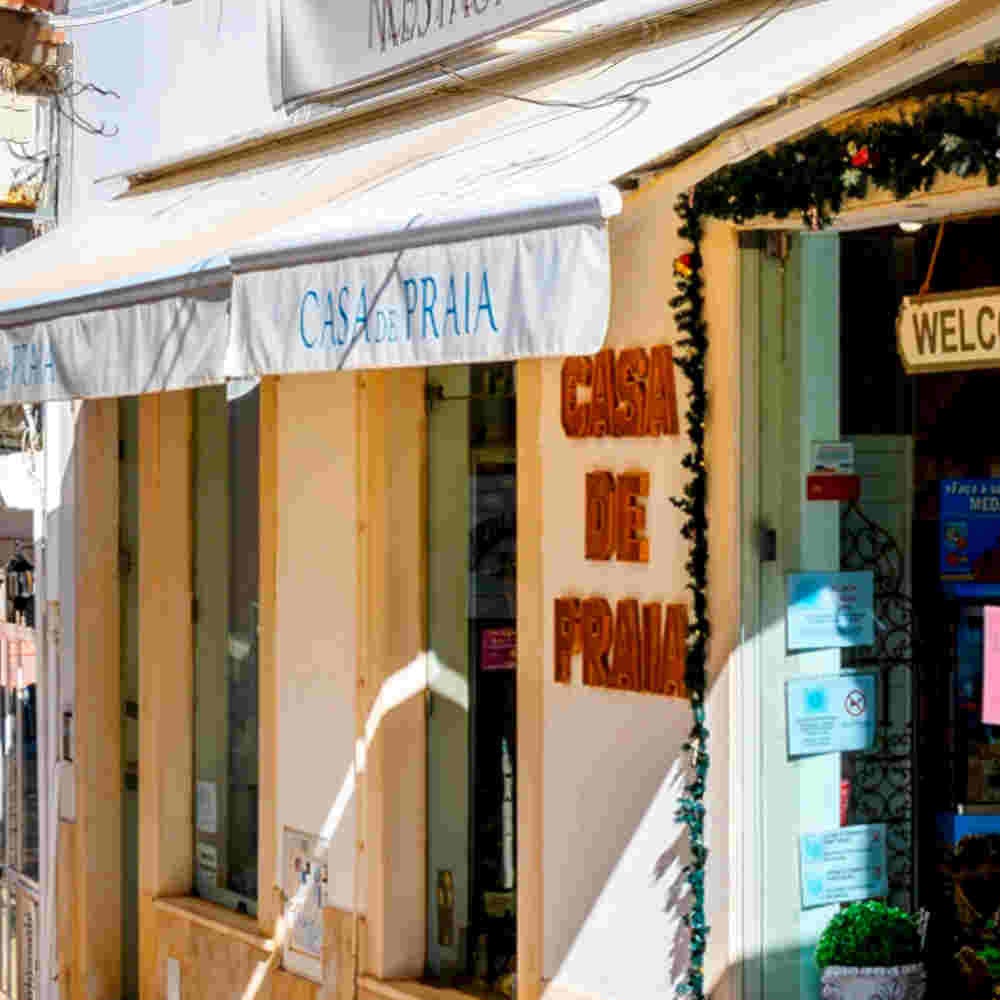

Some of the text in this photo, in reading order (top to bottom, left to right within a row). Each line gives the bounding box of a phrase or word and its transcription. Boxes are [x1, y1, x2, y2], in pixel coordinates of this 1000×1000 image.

[299, 285, 372, 349] CASA
[402, 269, 500, 339] PRAIA
[560, 344, 680, 438] CASA
[585, 470, 650, 563] DE
[553, 597, 690, 700] PRAIA
